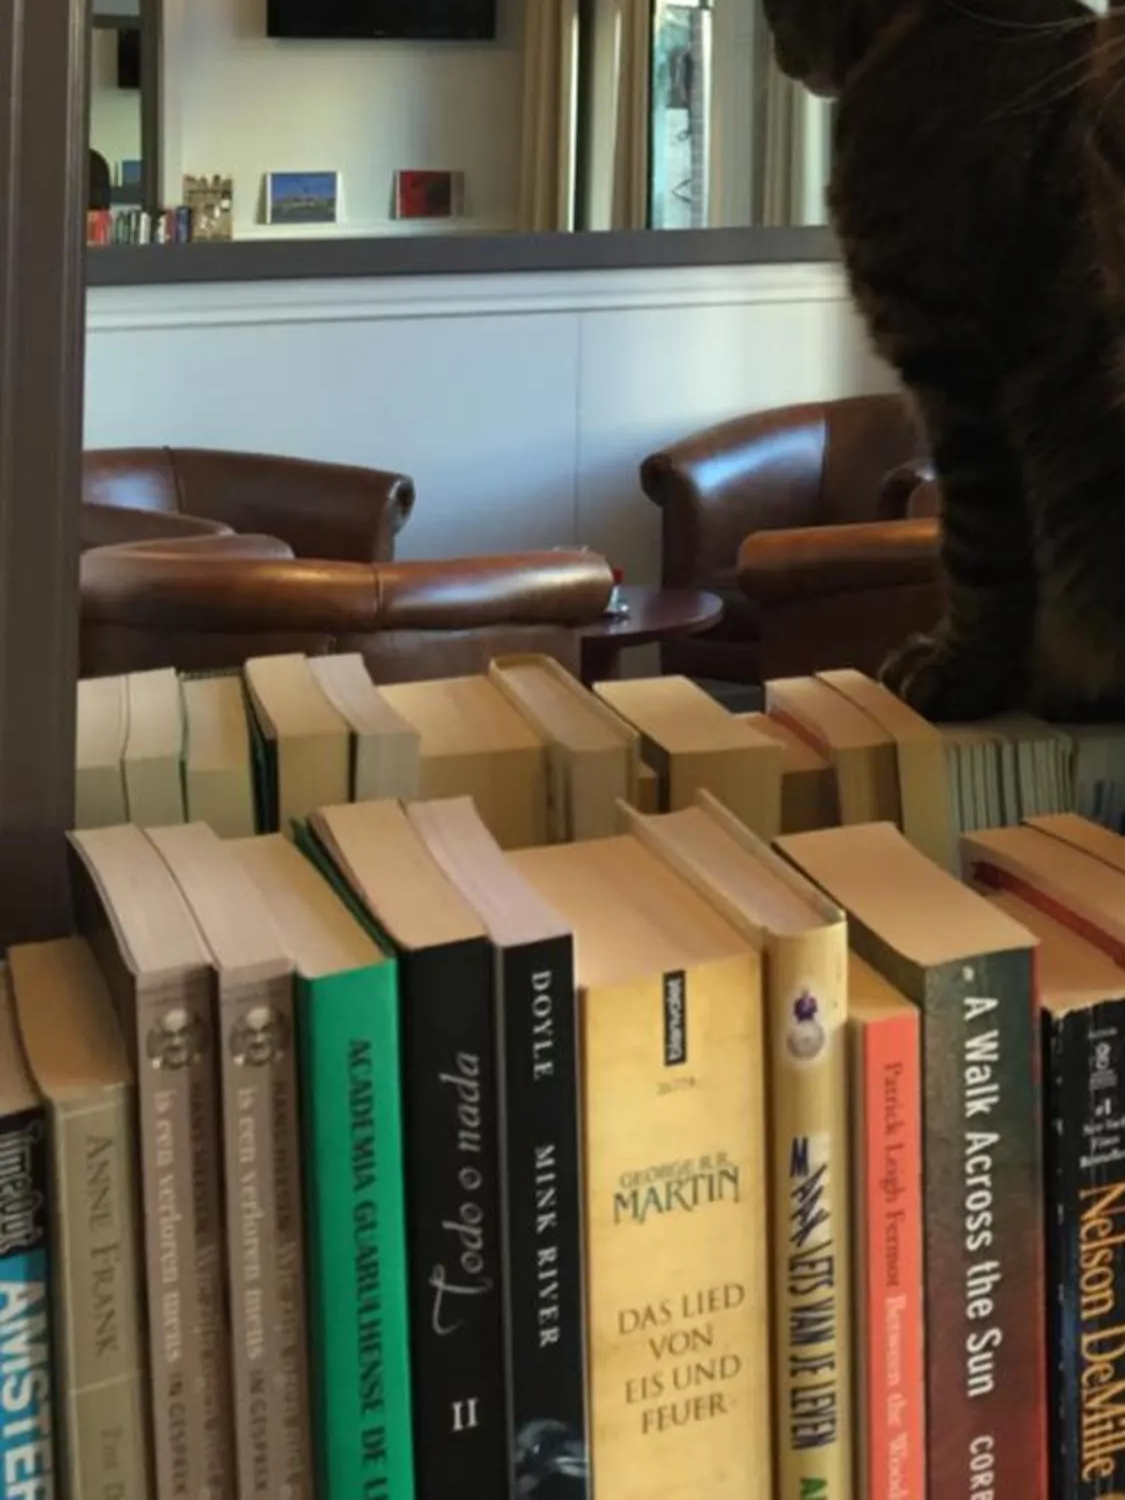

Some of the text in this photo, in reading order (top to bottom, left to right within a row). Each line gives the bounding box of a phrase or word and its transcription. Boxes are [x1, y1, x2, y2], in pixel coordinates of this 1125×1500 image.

[531, 968, 555, 1082] DOYLE
[153, 1088, 177, 1114] is
[238, 1086, 259, 1111] is
[882, 1061, 904, 1136] Patrick
[154, 1119, 177, 1168] een
[239, 1115, 259, 1163] een
[431, 1051, 493, 1335] Todo o nada
[613, 1165, 741, 1225] MARTIN
[618, 1158, 694, 1189] GEORGE
[880, 1143, 906, 1204] Leigh
[963, 995, 1002, 1398] A Walk Across the Sun
[83, 1133, 123, 1359] ANNE FRANK
[157, 1173, 183, 1284] verloren
[240, 1170, 266, 1282] verloren
[347, 1038, 377, 1193] ACADEMIA
[362, 1425, 389, 1471] DE
[534, 1144, 560, 1348] MINK RIVER
[883, 1210, 905, 1288] Fermor
[162, 1290, 185, 1363] mens
[243, 1288, 266, 1362] mens
[617, 1282, 746, 1336] DAS LIED
[648, 1322, 714, 1361] VON
[789, 1297, 836, 1348] VAN
[884, 1292, 908, 1386] Between
[625, 1353, 743, 1405] EIS UND
[789, 1351, 837, 1379] JE
[451, 1398, 480, 1431] II
[641, 1391, 729, 1436] FEUER
[790, 1380, 838, 1451] LEVEN
